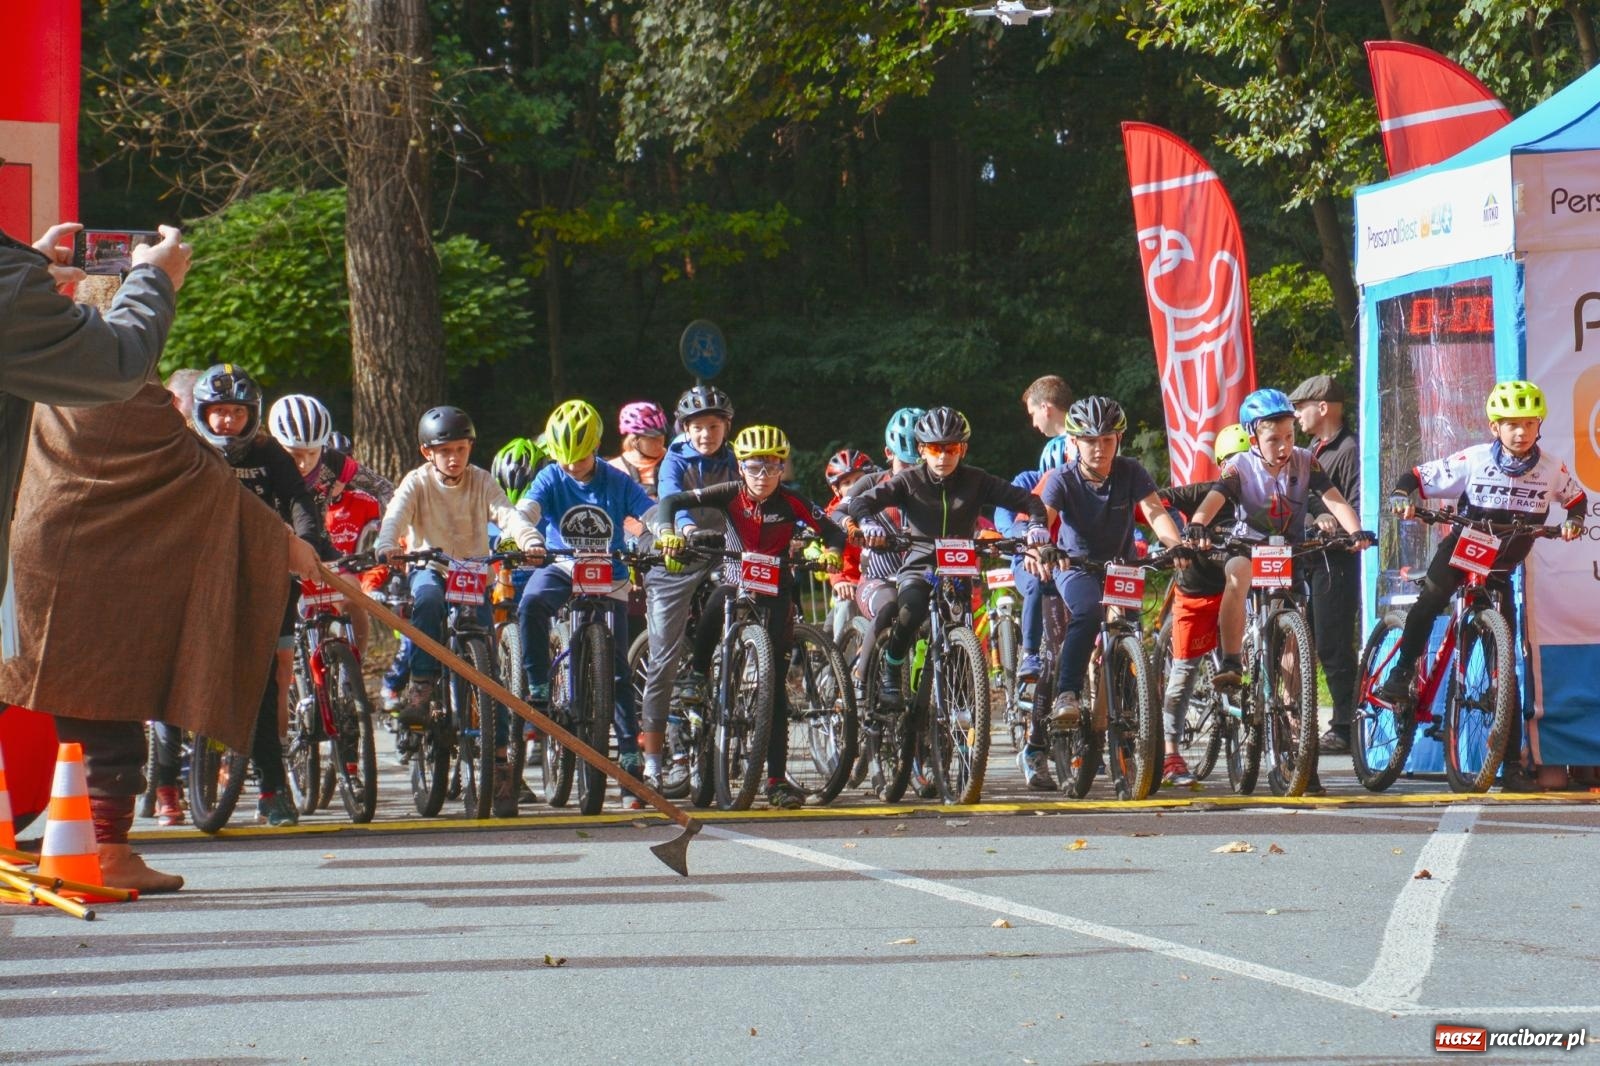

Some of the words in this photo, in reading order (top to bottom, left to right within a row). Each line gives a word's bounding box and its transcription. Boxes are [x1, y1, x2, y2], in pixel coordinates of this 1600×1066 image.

[1483, 206, 1499, 222] MITKO
[1471, 483, 1549, 500] TREK
[1516, 499, 1546, 509] RACING
[944, 551, 969, 563] 60
[1465, 544, 1487, 559] 67
[585, 567, 601, 579] 61
[750, 565, 772, 580] 65
[1260, 560, 1284, 573] 59
[456, 575, 478, 589] 64
[1114, 580, 1136, 594] 98
